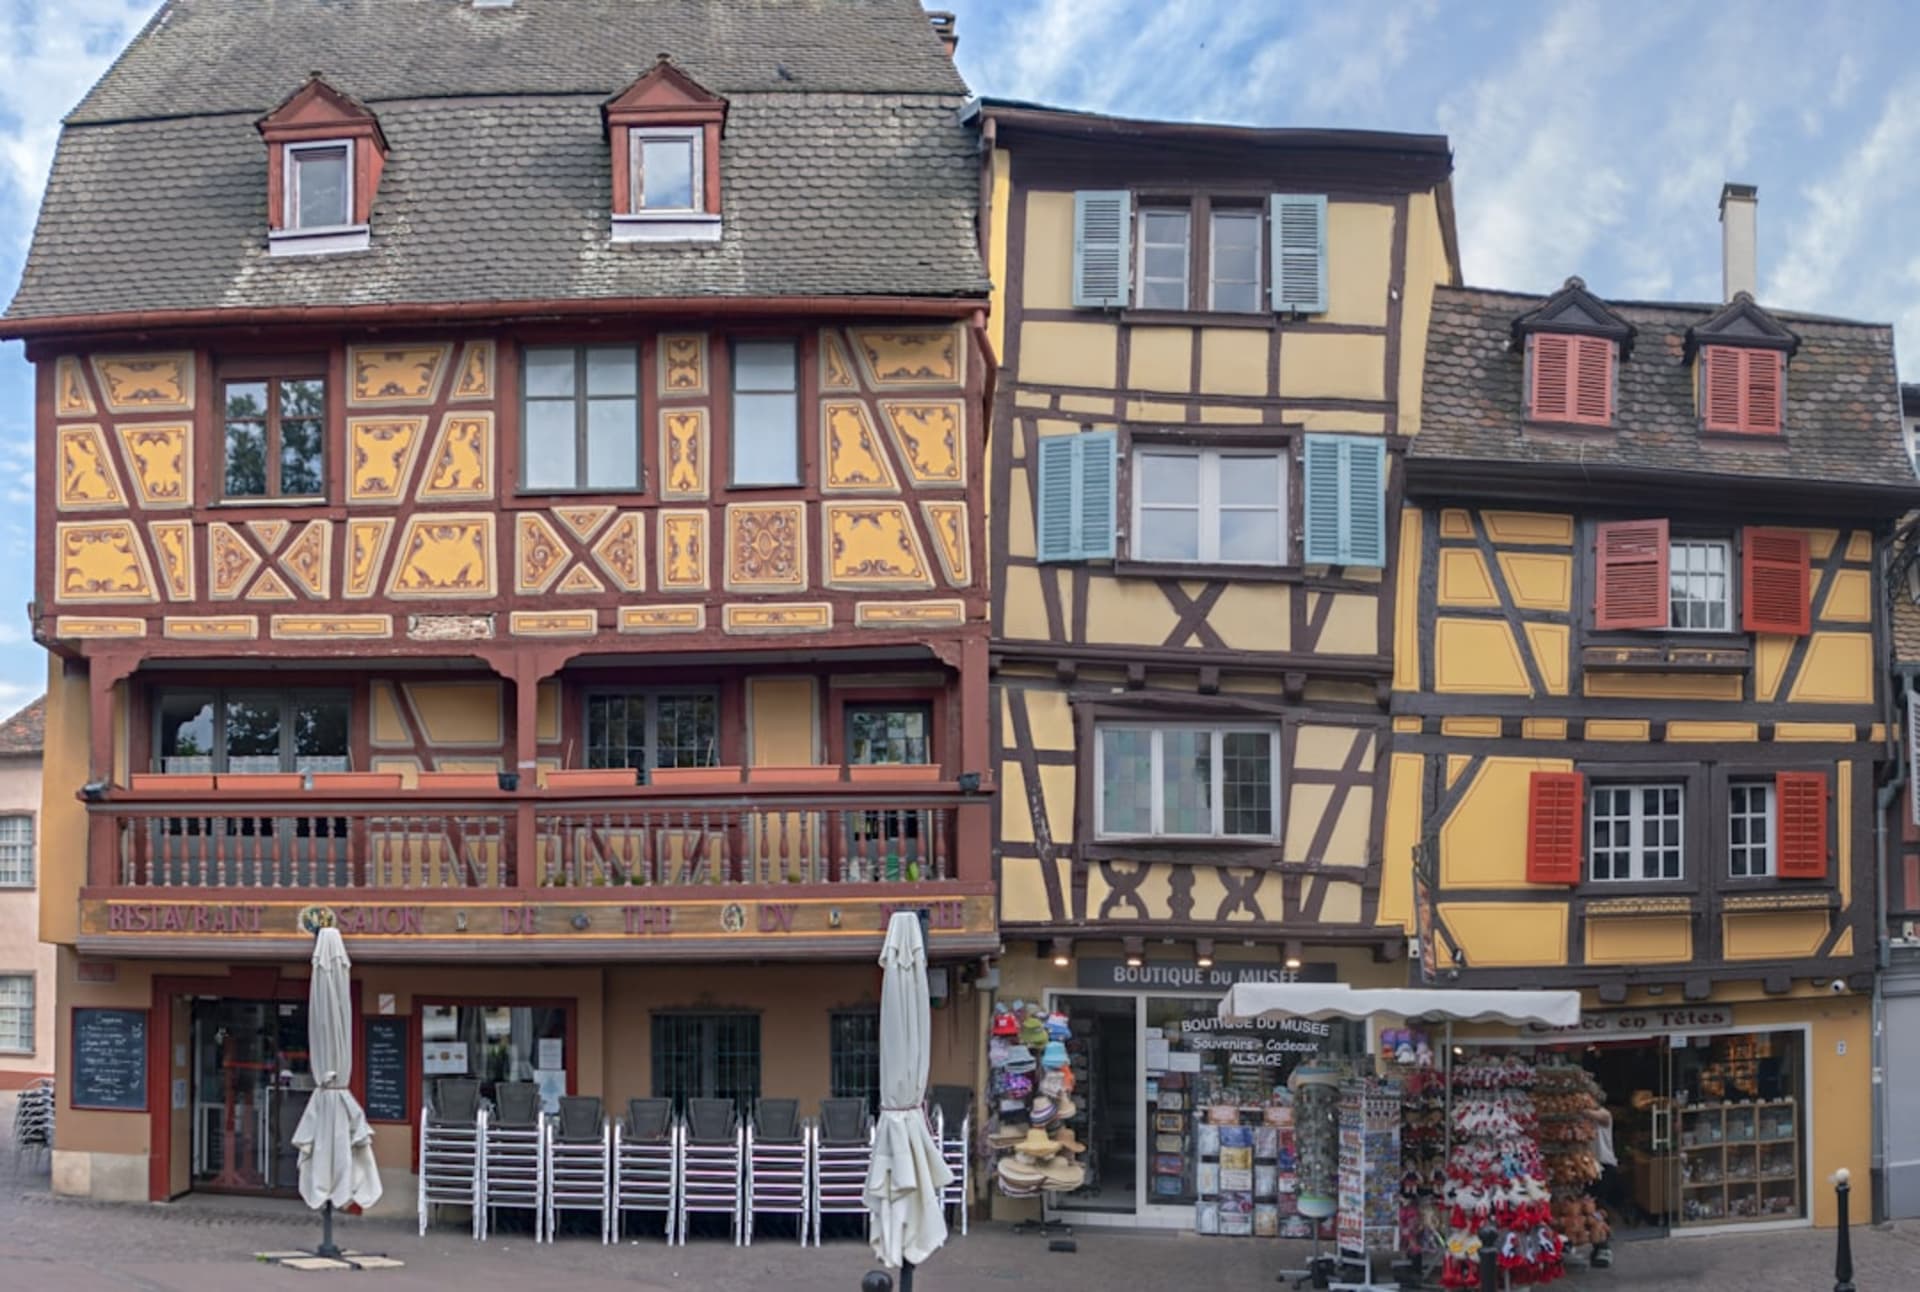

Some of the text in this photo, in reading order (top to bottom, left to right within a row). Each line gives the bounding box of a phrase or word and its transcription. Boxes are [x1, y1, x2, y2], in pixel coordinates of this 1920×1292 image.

[336, 906, 424, 934] SALON
[503, 906, 537, 934] DE
[1113, 966, 1204, 986] BOUTIQUE
[1210, 970, 1232, 985] DU
[1256, 1018, 1277, 1029] DU
[1618, 1014, 1646, 1029] en
[1657, 1010, 1724, 1027] Têtes
[1192, 1037, 1254, 1051] Souvenirs
[1266, 1039, 1319, 1052] Cadeaux
[1230, 1053, 1282, 1067] ALSACE
